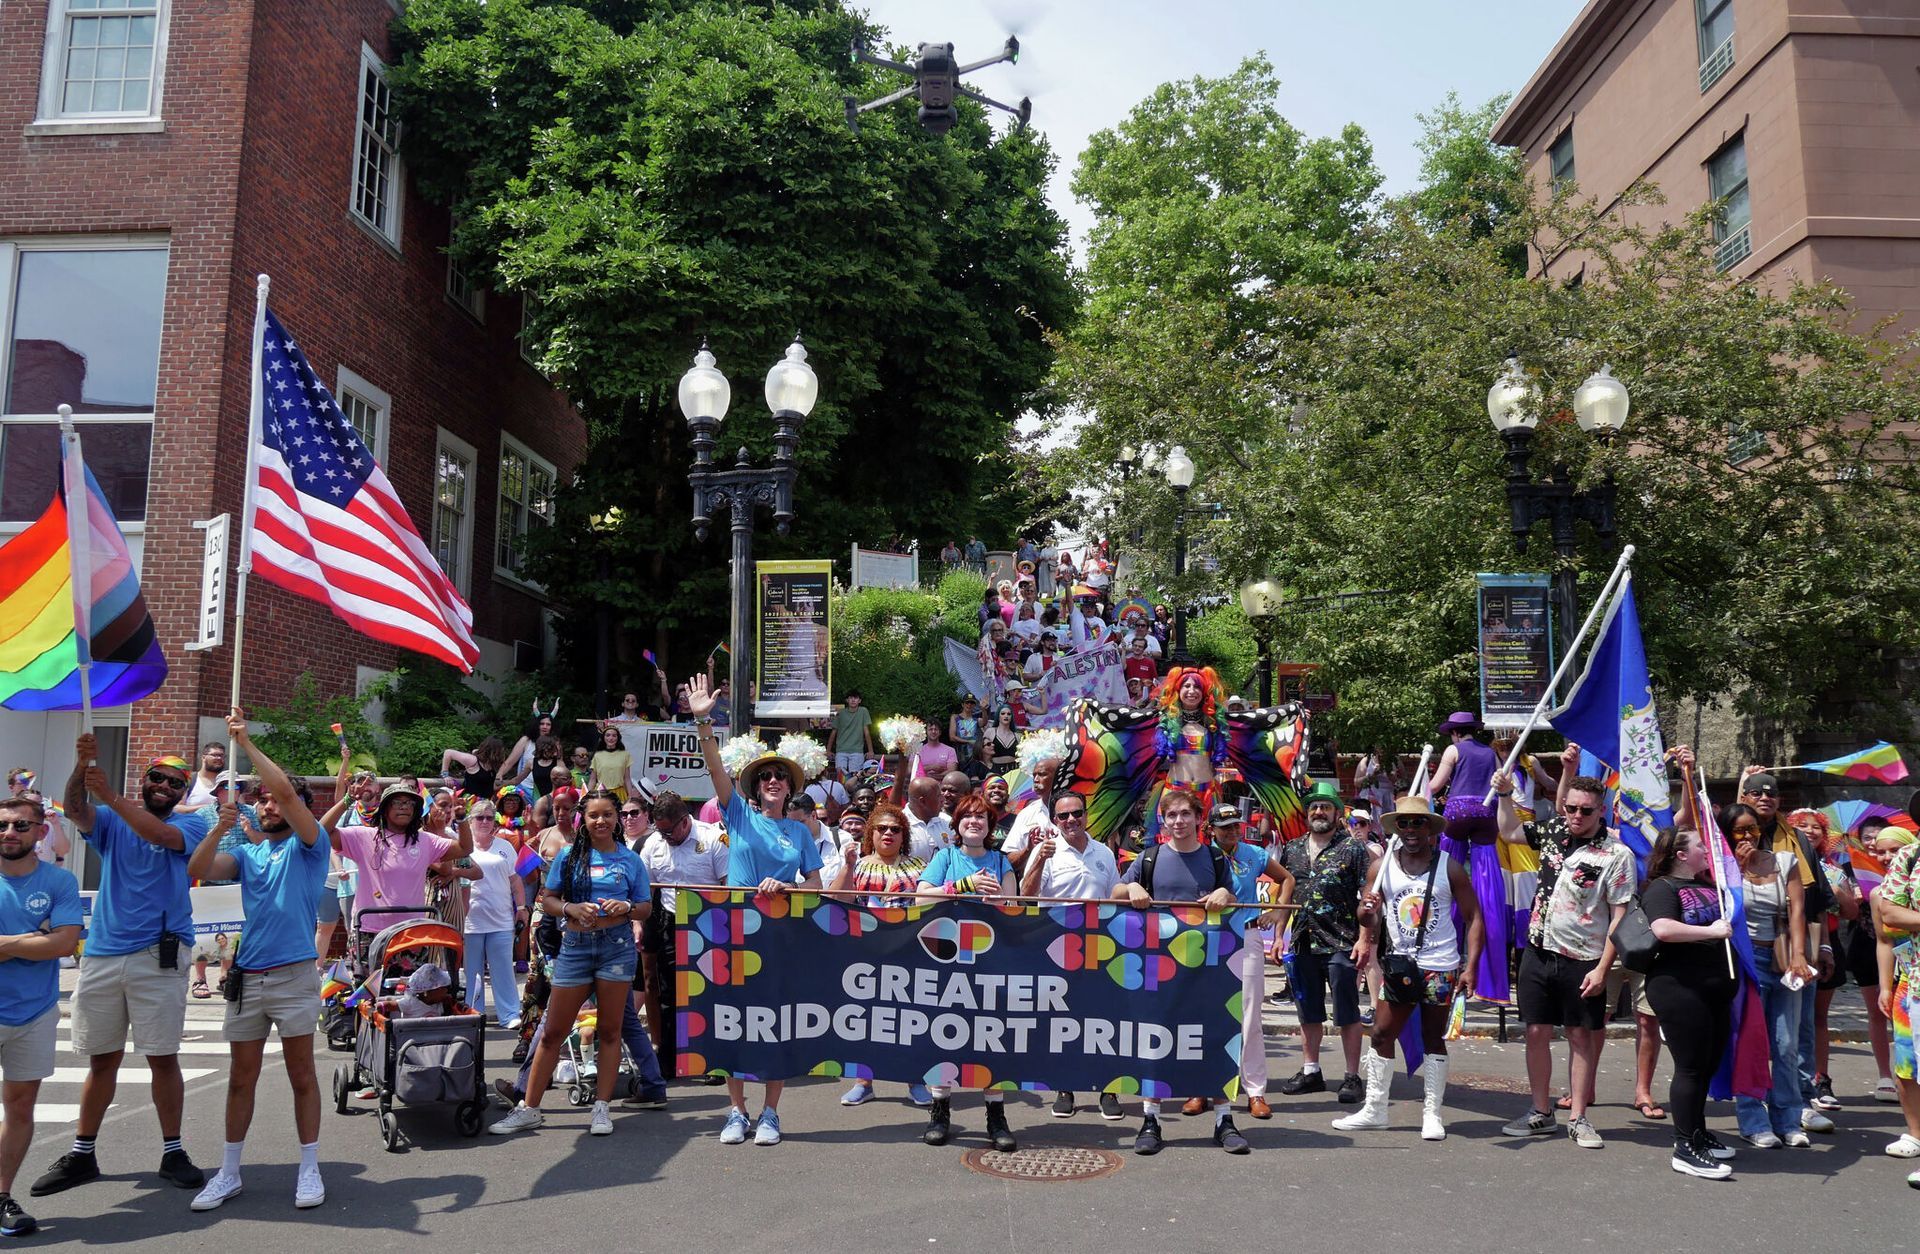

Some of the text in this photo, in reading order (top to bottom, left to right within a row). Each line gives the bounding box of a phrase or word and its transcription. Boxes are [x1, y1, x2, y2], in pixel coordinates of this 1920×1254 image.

[648, 756, 708, 769] PRID
[220, 923, 243, 931] Waste.
[841, 962, 1069, 1012] GREATER
[713, 1003, 1204, 1061] BRIDGEPORT PRIDE
